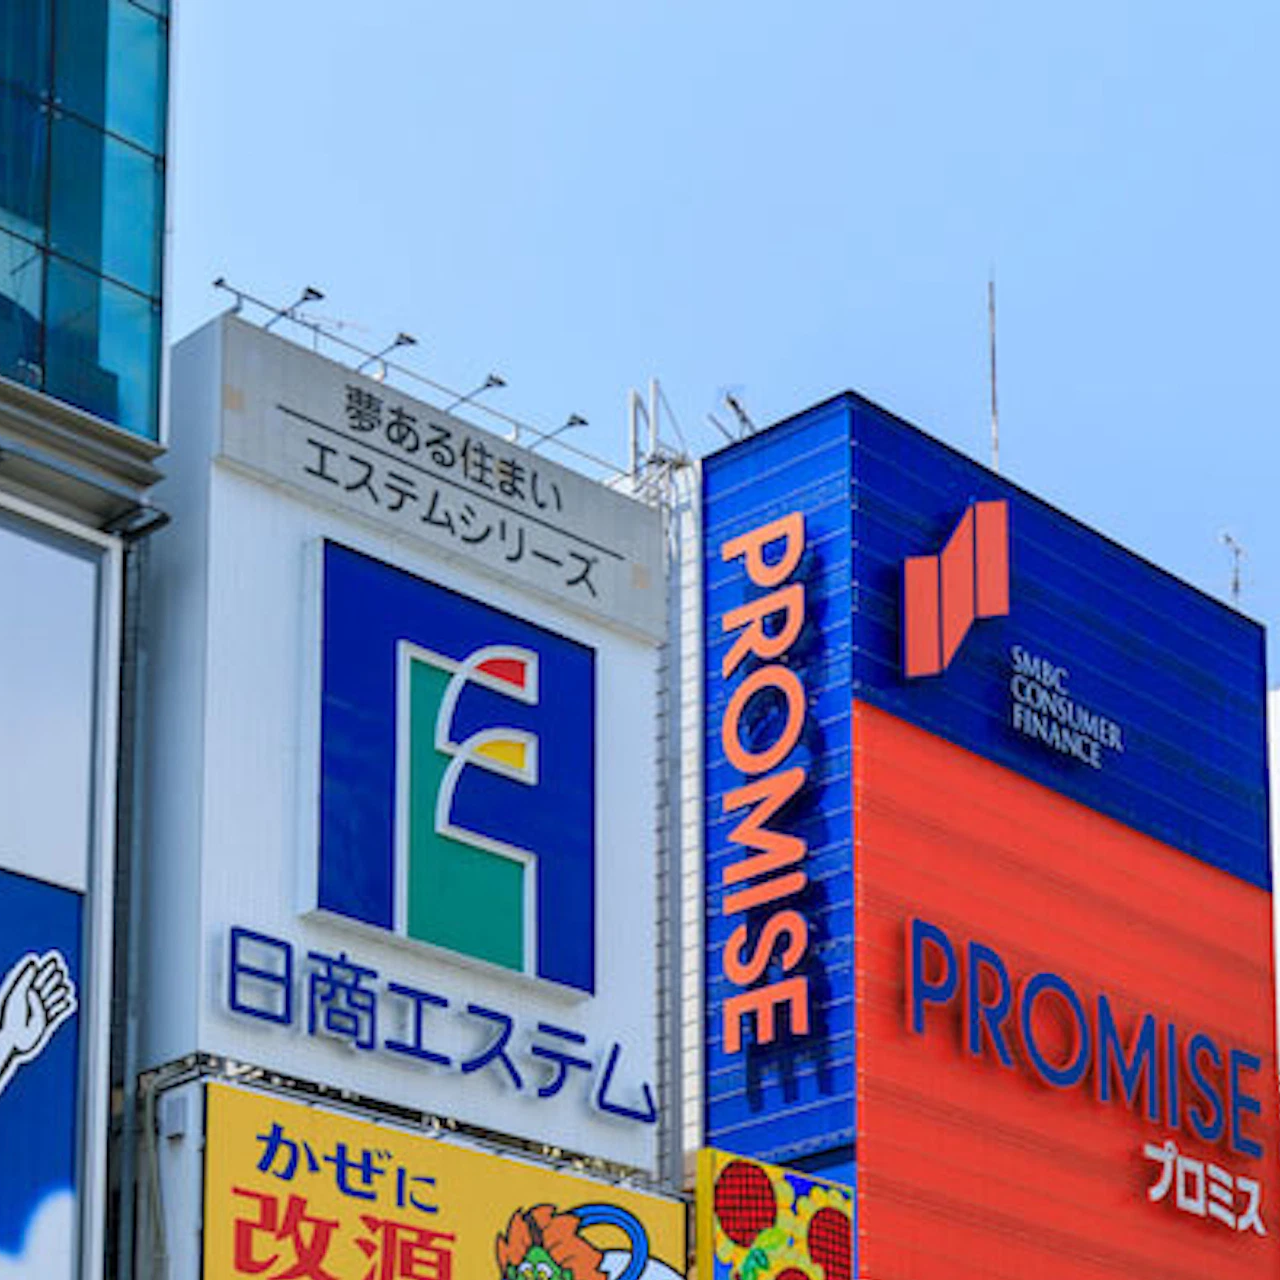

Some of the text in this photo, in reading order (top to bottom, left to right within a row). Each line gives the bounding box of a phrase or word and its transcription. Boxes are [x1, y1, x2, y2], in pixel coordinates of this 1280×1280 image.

[344, 383, 562, 512] 夢ある住まい
[304, 437, 599, 598] エステムシリーズ
[1010, 674, 1125, 754] CONSUMER
[1011, 644, 1070, 697] SMBC
[721, 511, 809, 1054] PROMISE
[1012, 702, 1103, 770] FINANCE
[229, 926, 658, 1124] 日商エステム
[907, 916, 1264, 1162] PROMISE
[256, 1121, 439, 1214] かぜに
[1143, 1142, 1268, 1238] プロミス
